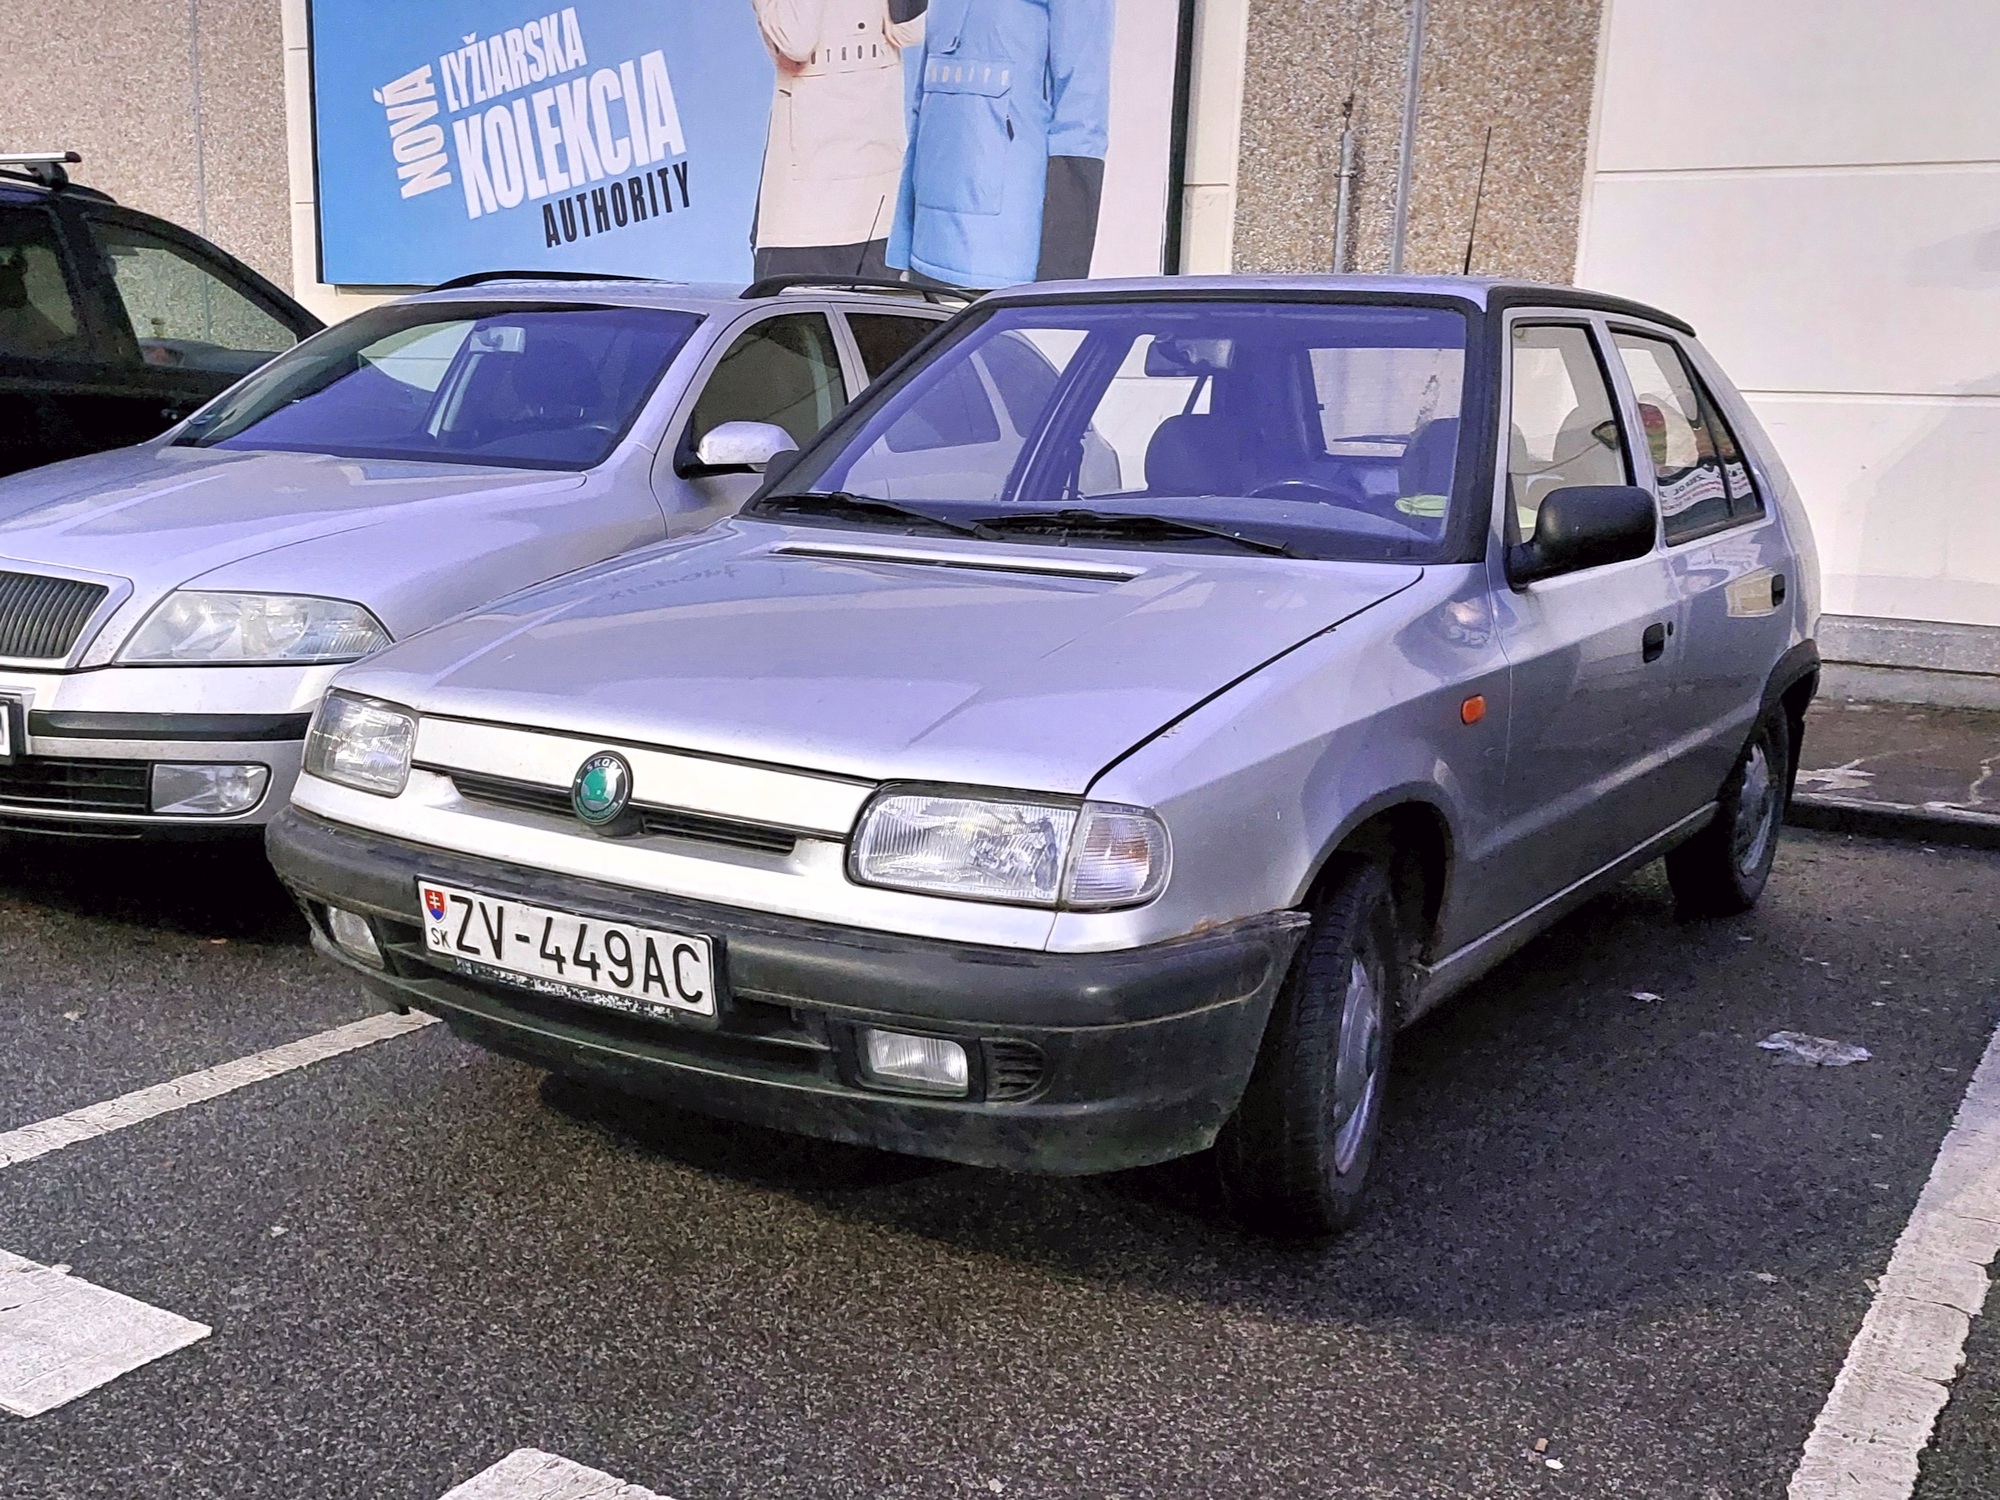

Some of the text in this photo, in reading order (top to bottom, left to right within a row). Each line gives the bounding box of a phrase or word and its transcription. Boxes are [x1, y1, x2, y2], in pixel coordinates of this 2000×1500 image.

[439, 6, 588, 113] LYŽIARSKA
[373, 63, 452, 199] NOVÁ
[452, 49, 687, 220] KOLEKCIA
[542, 161, 691, 249] AUTHORITY
[430, 927, 451, 949] SK
[450, 894, 703, 1004] ZV-449AC
